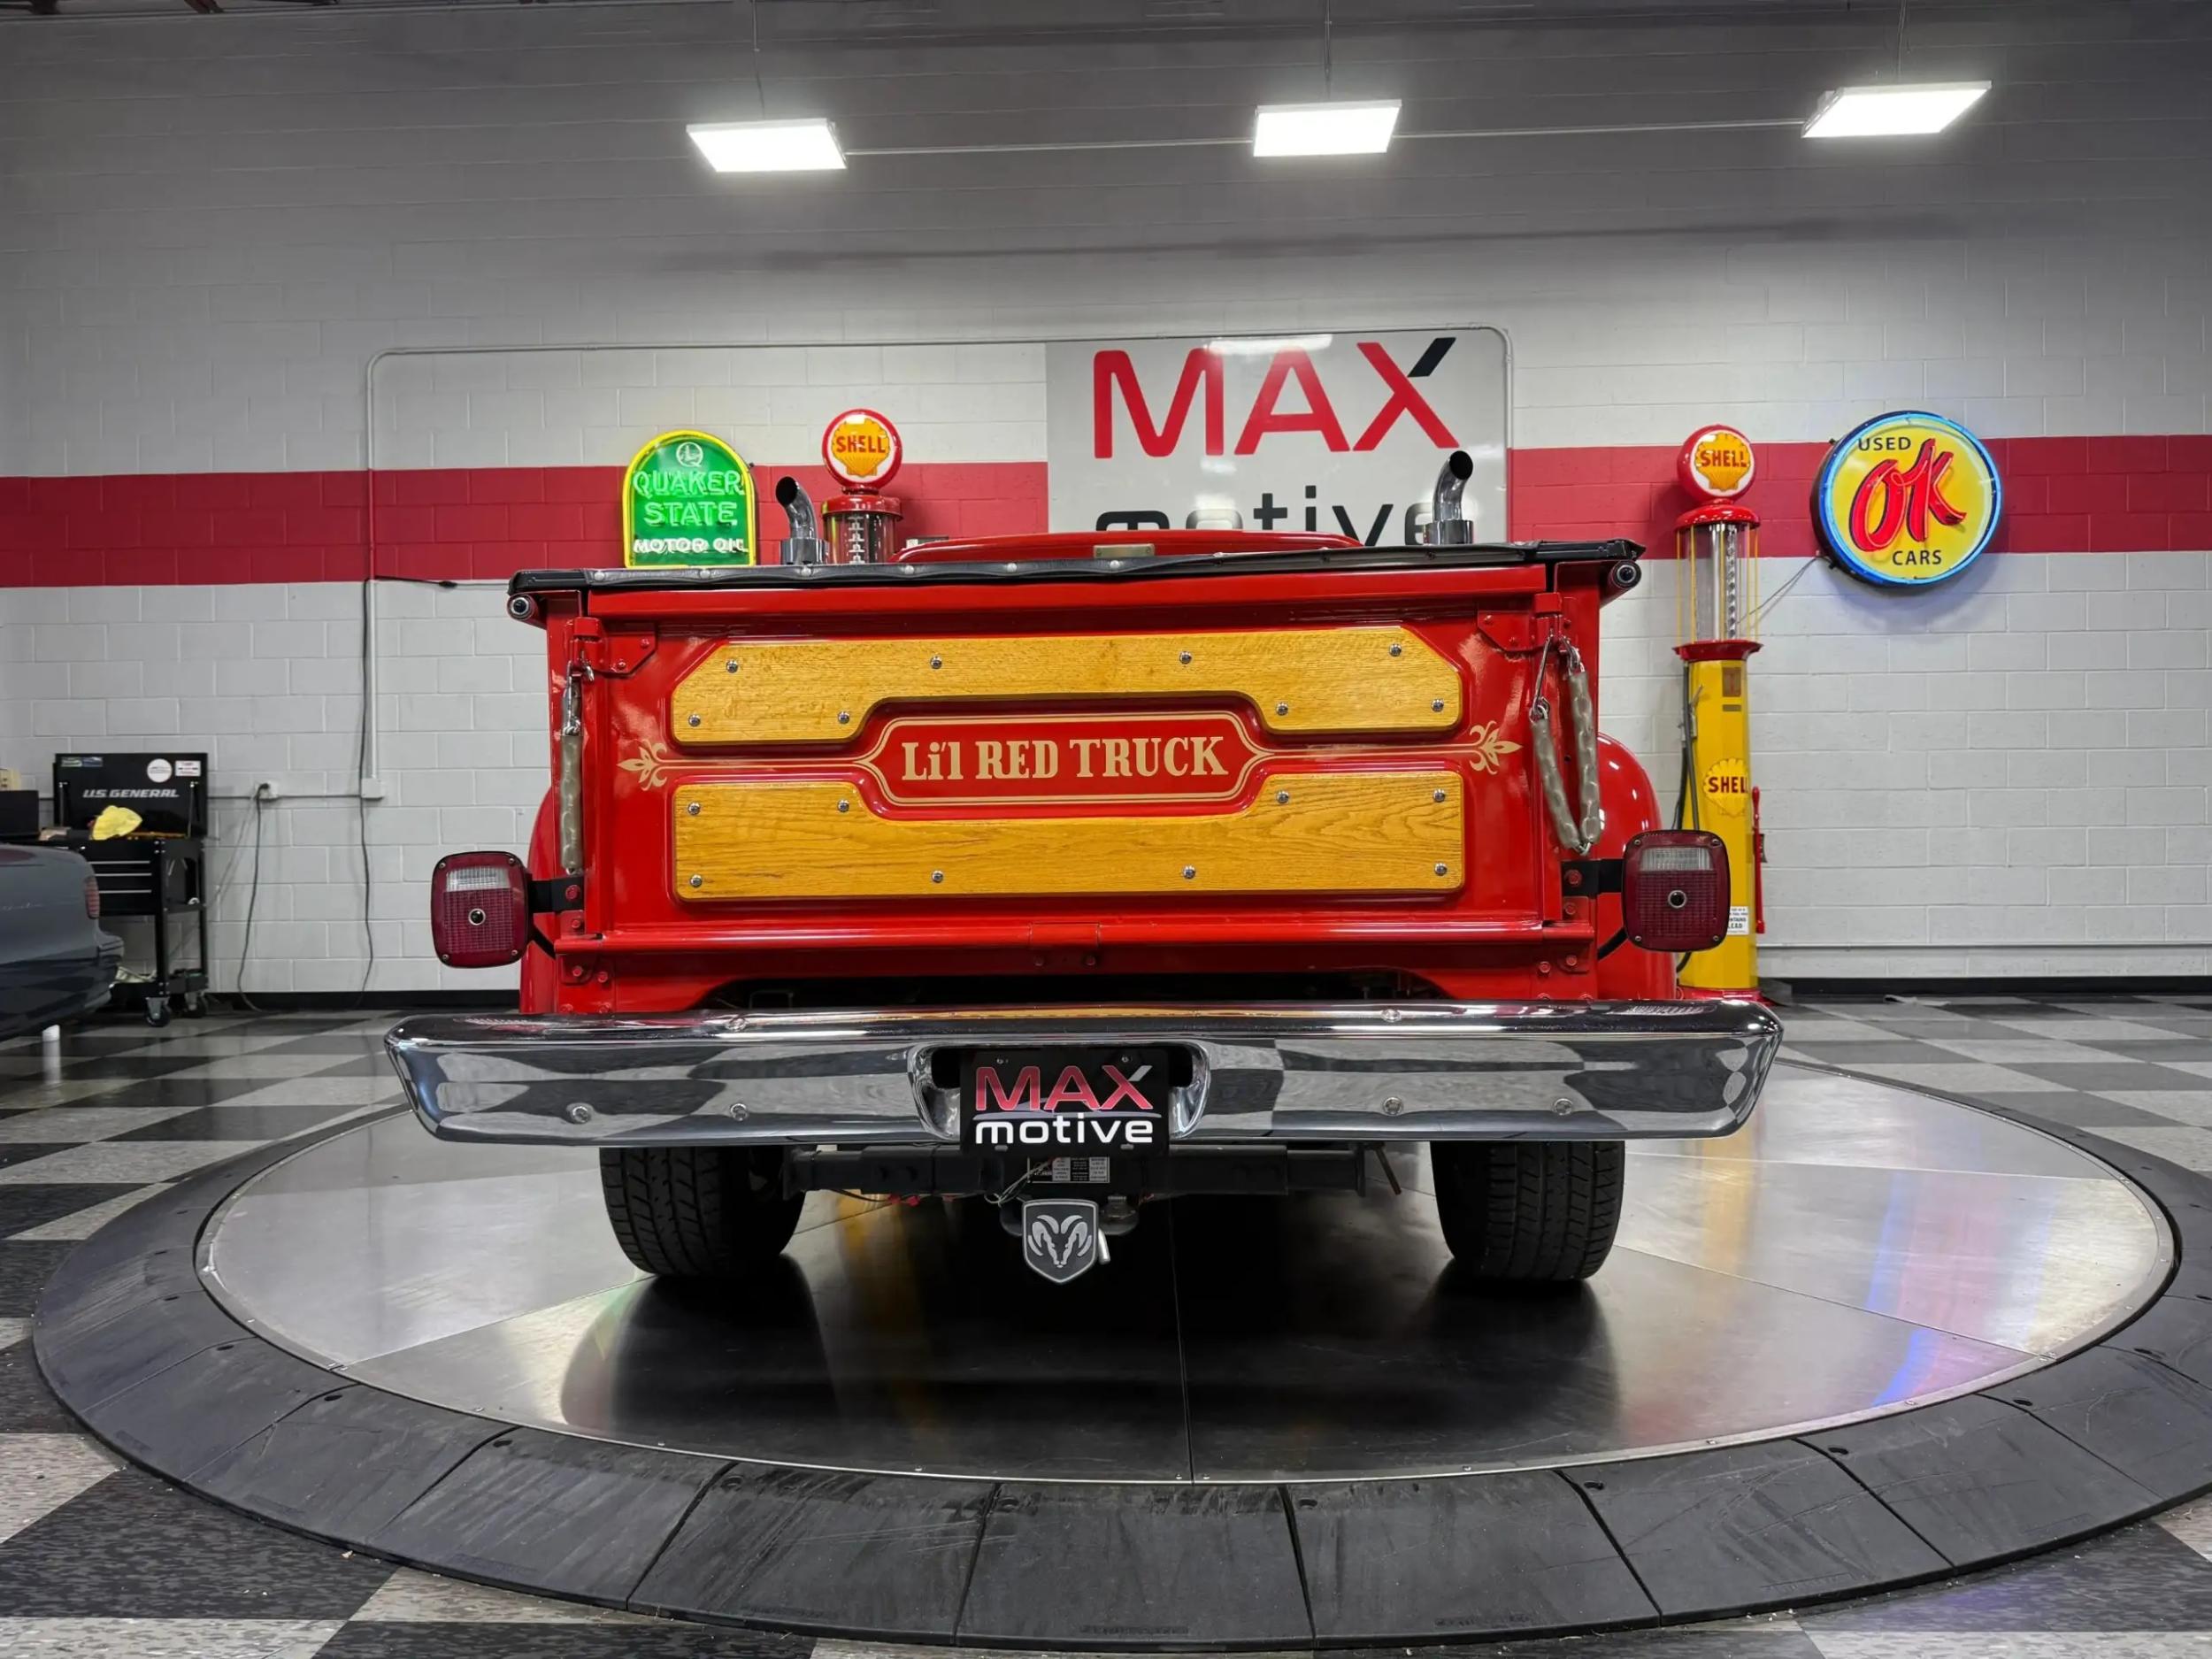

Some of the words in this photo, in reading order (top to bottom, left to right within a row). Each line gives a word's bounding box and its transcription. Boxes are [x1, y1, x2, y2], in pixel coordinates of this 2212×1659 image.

[1094, 337, 1461, 458] MAX
[836, 434, 886, 454] SHELL
[1858, 436, 1911, 451] USED
[1701, 449, 1749, 467] SHELL
[633, 470, 745, 499] QUAKER
[1849, 438, 1967, 552] OK
[643, 501, 738, 526] STATE
[634, 537, 710, 554] MOTOR
[712, 537, 749, 553] OIL
[1892, 549, 1942, 565] CARS
[902, 741, 964, 780] Li'l
[975, 741, 1058, 780] RED
[1069, 736, 1229, 778] TRUCK
[109, 789, 180, 798] GENERAL
[1708, 776, 1748, 794] SHEL
[976, 1064, 1153, 1111] MAX
[975, 1112, 1153, 1144] motive
